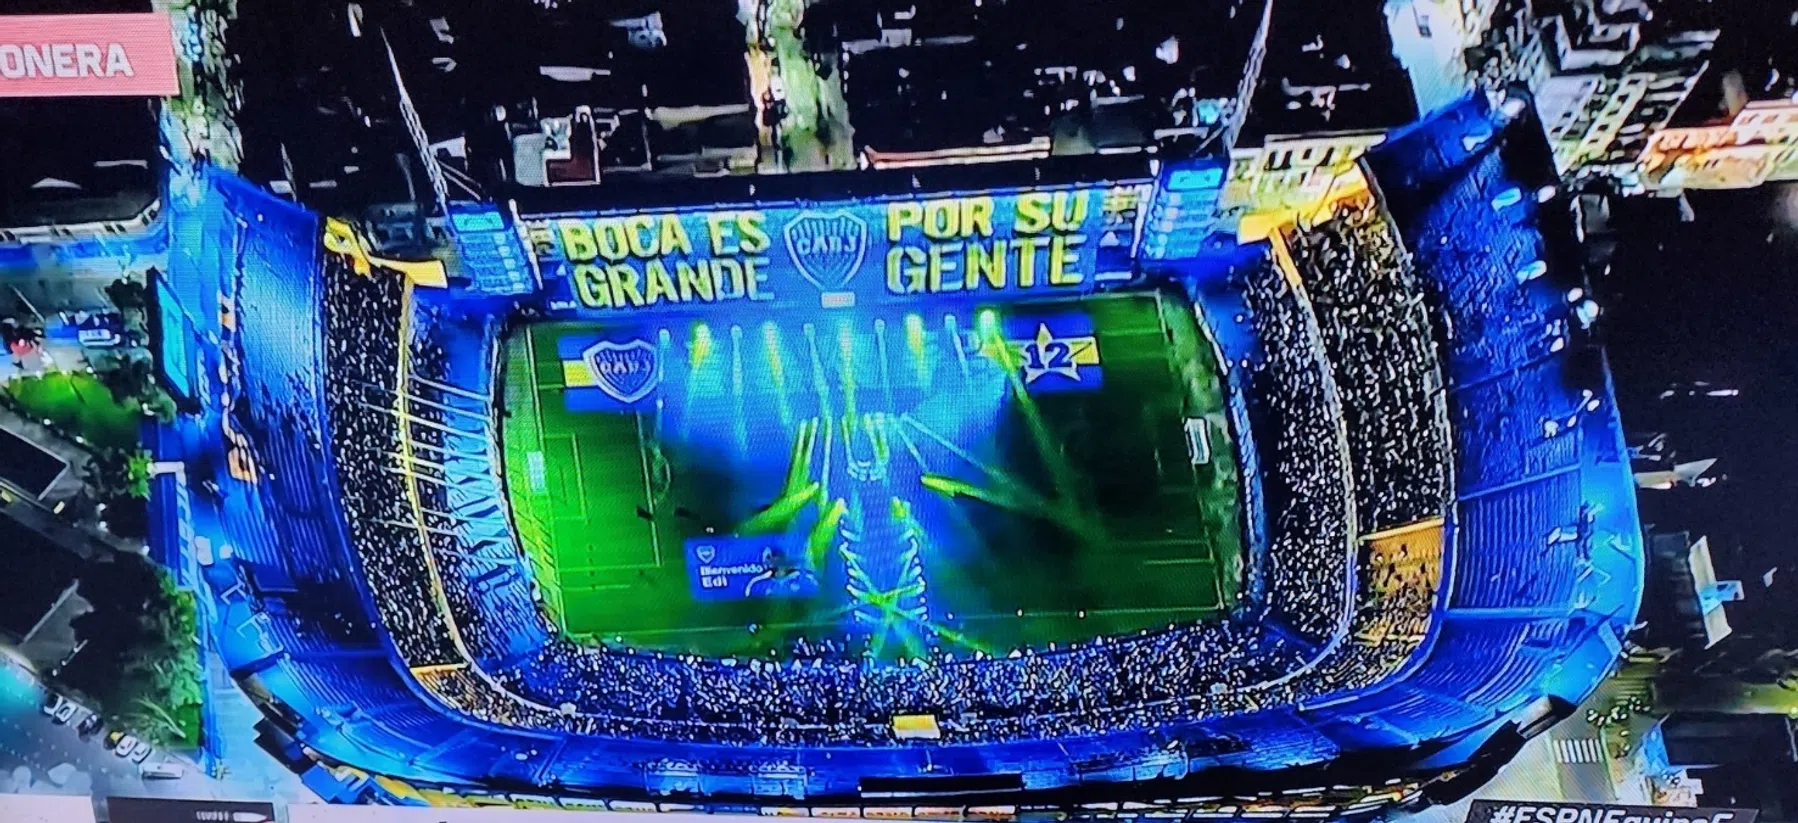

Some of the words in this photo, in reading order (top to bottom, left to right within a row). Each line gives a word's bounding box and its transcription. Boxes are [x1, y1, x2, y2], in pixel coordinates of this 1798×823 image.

[557, 213, 693, 262] BOCA
[706, 210, 772, 256] ES
[886, 196, 994, 241] POR
[1013, 189, 1090, 234] SU
[573, 256, 775, 308] GRANDE
[886, 234, 1088, 294] GENTE
[1025, 342, 1073, 369] 12
